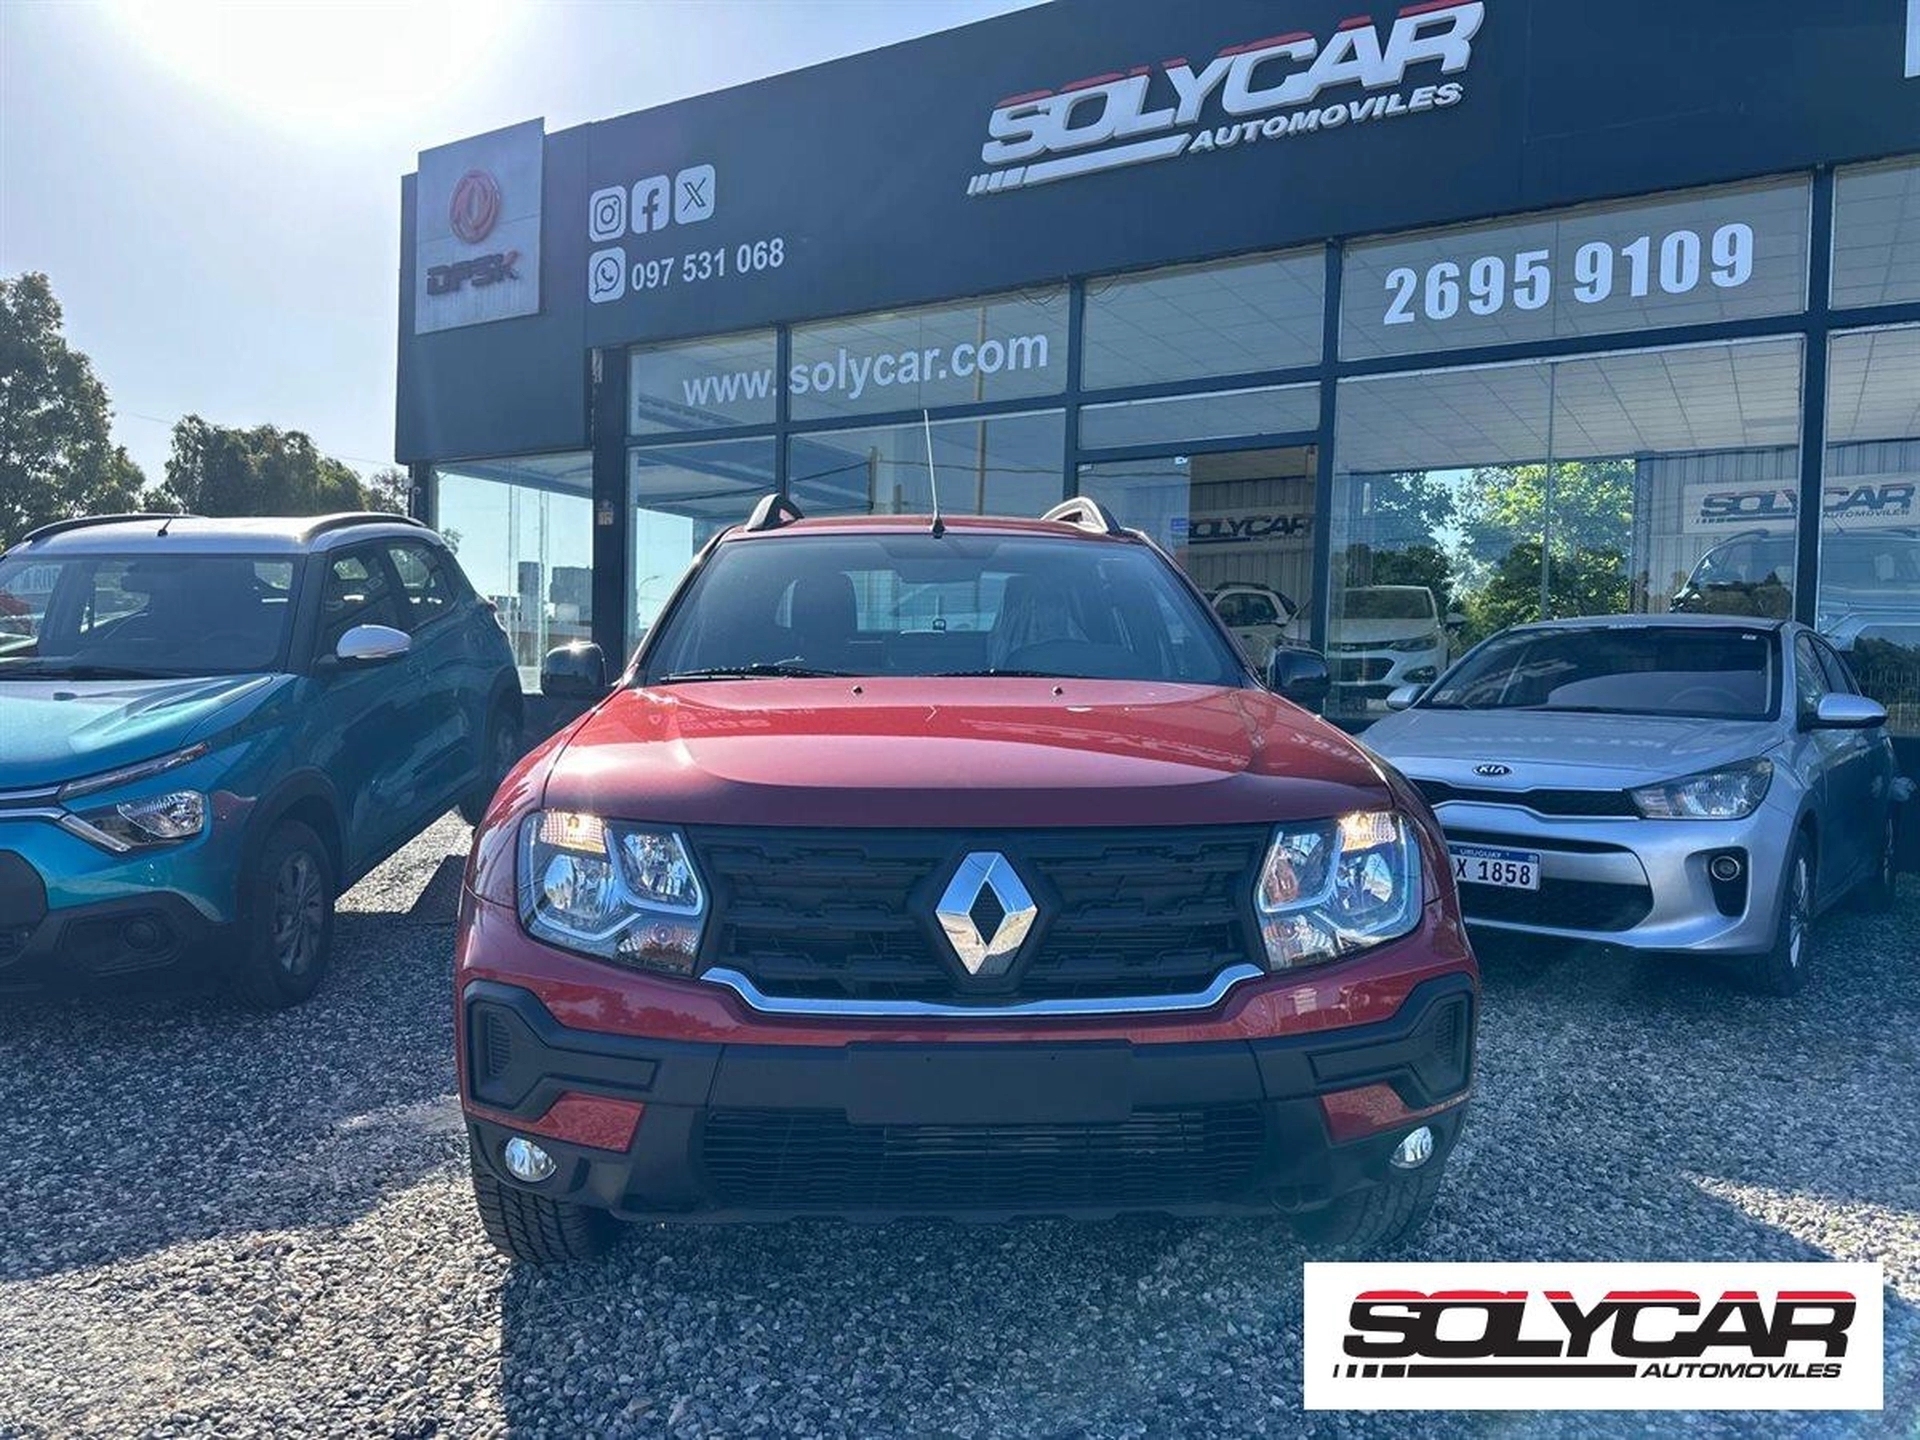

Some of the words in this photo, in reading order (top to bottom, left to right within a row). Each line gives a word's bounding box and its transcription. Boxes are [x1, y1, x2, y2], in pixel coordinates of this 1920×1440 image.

[980, 0, 1485, 165] SOLYCAR
[1188, 82, 1463, 153] AUTOMOVILES
[631, 257, 675, 292] 097
[682, 247, 727, 282] 531
[736, 237, 785, 275] 068
[1383, 249, 1551, 325] 2695
[1574, 223, 1754, 304] 9109
[1478, 860, 1531, 885] 1858
